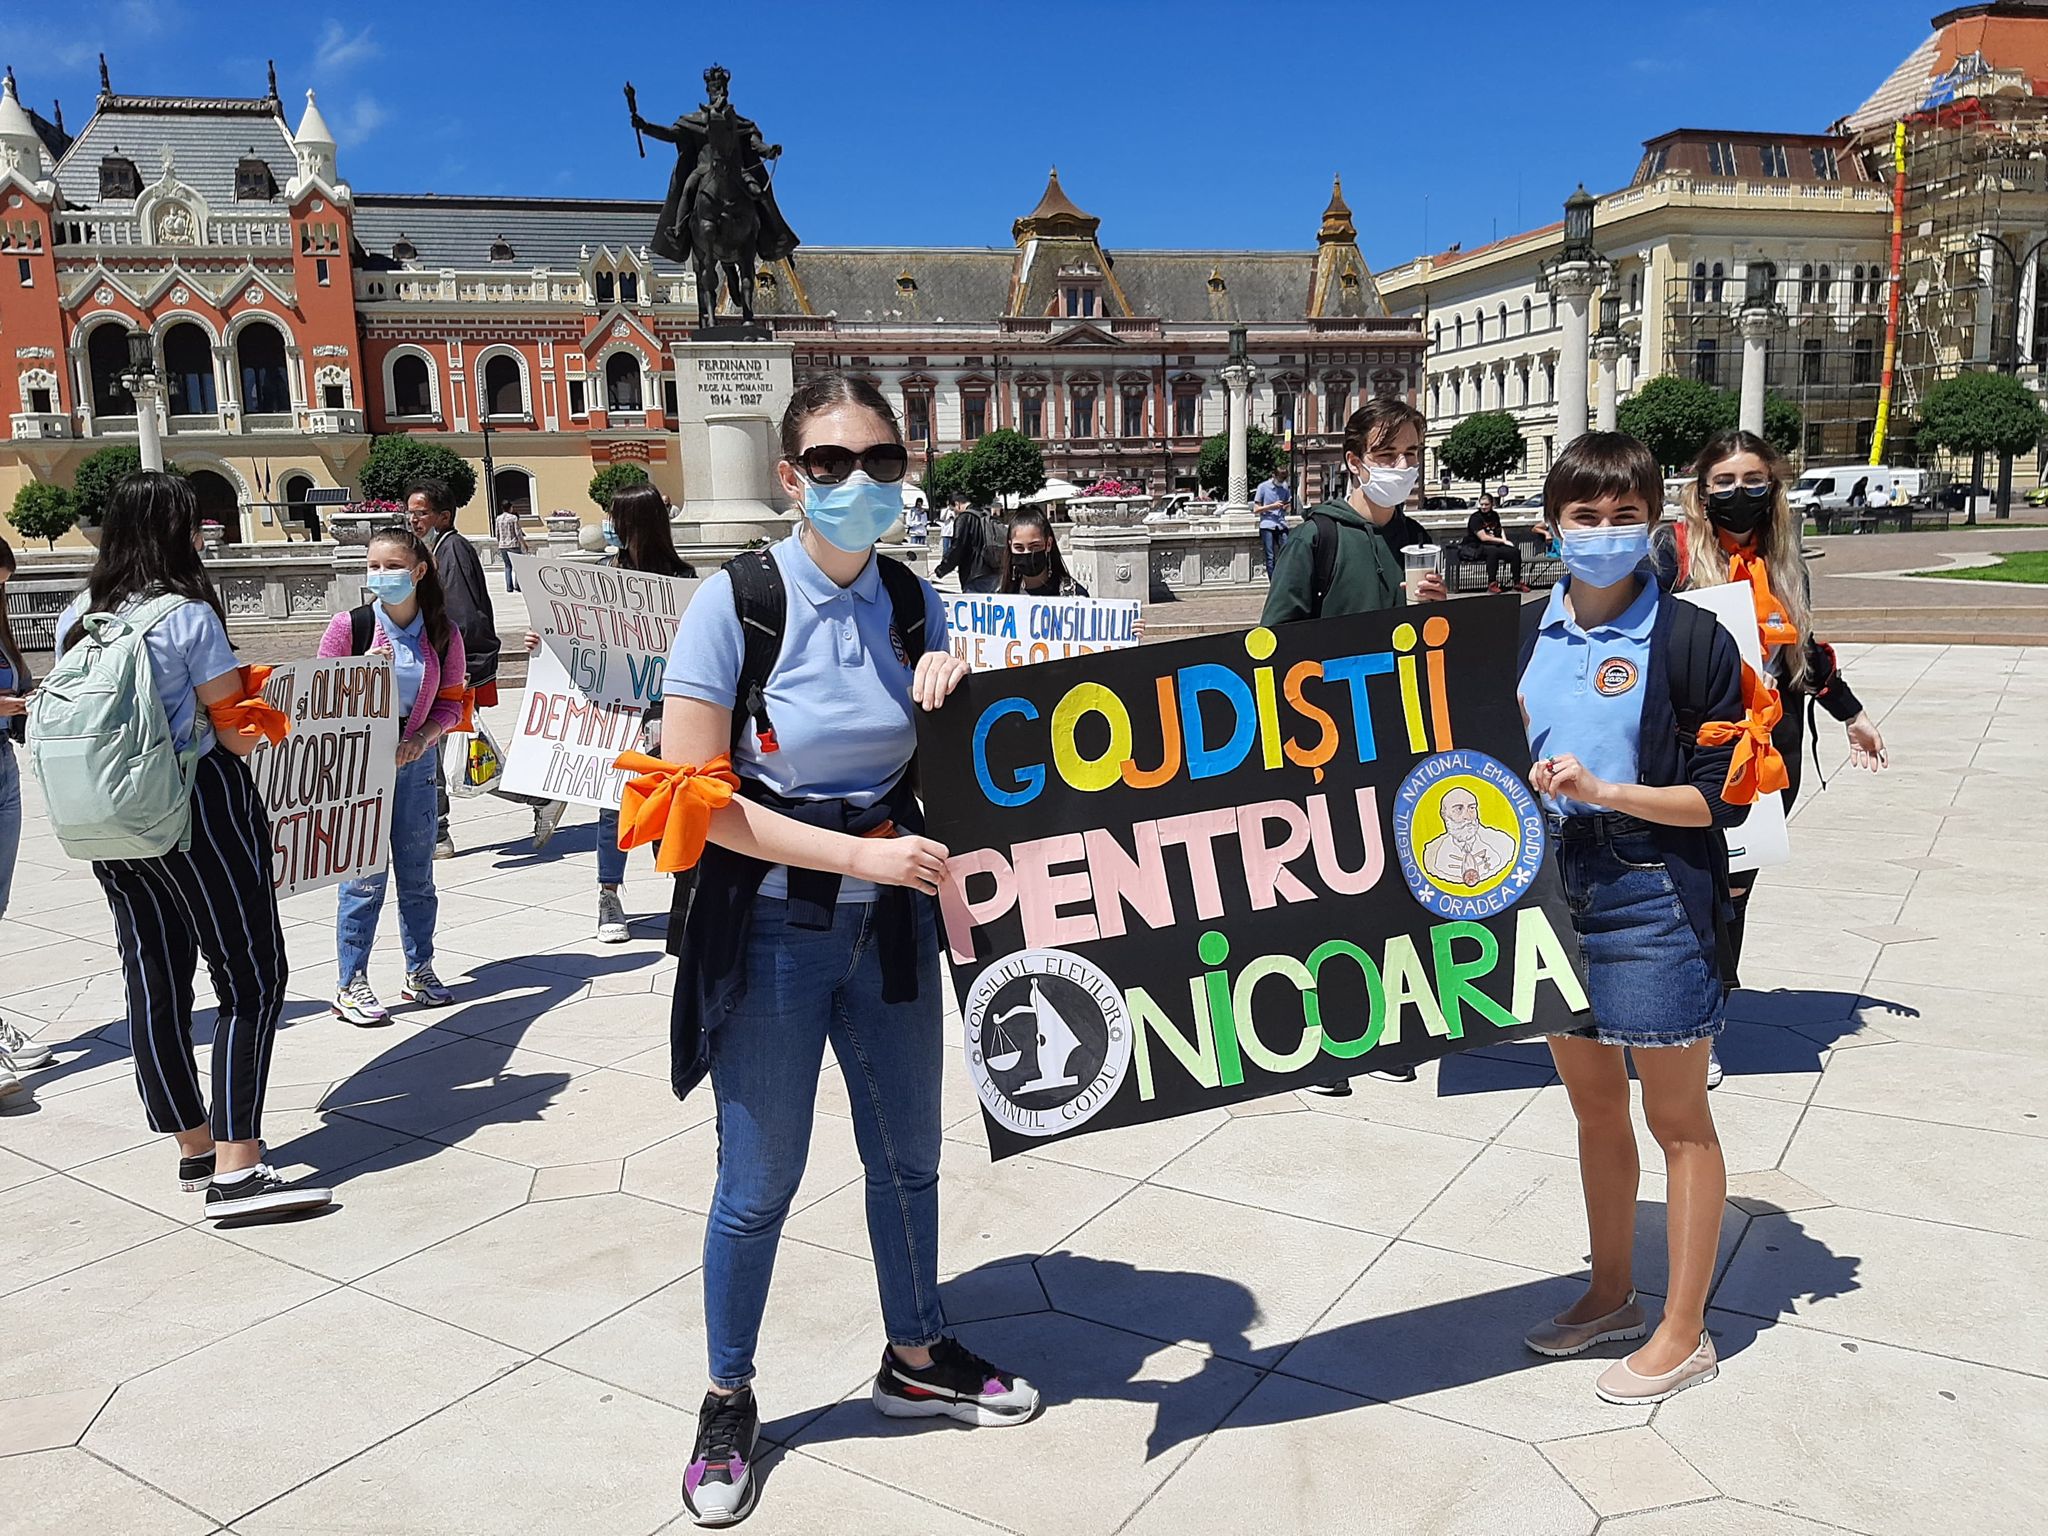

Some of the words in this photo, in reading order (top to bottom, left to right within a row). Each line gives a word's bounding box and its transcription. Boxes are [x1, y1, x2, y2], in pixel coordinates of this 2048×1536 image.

[698, 360, 762, 371] FERDINAND
[766, 360, 770, 371] I
[698, 383, 719, 392] REGE
[721, 383, 733, 392] AL
[735, 383, 773, 392] ROMANIEI
[710, 394, 731, 405] 1914
[740, 394, 762, 405] 1927
[1397, 810, 1422, 888] COLEGIUL
[944, 787, 1385, 966] PENTRU
[1438, 886, 1516, 916] ORADEA
[969, 958, 1035, 1044] CONSILIUL
[1045, 957, 1123, 1027] ELEVILOR
[981, 1076, 1045, 1128] EMANUIL
[1061, 1063, 1118, 1121] GOJDU
